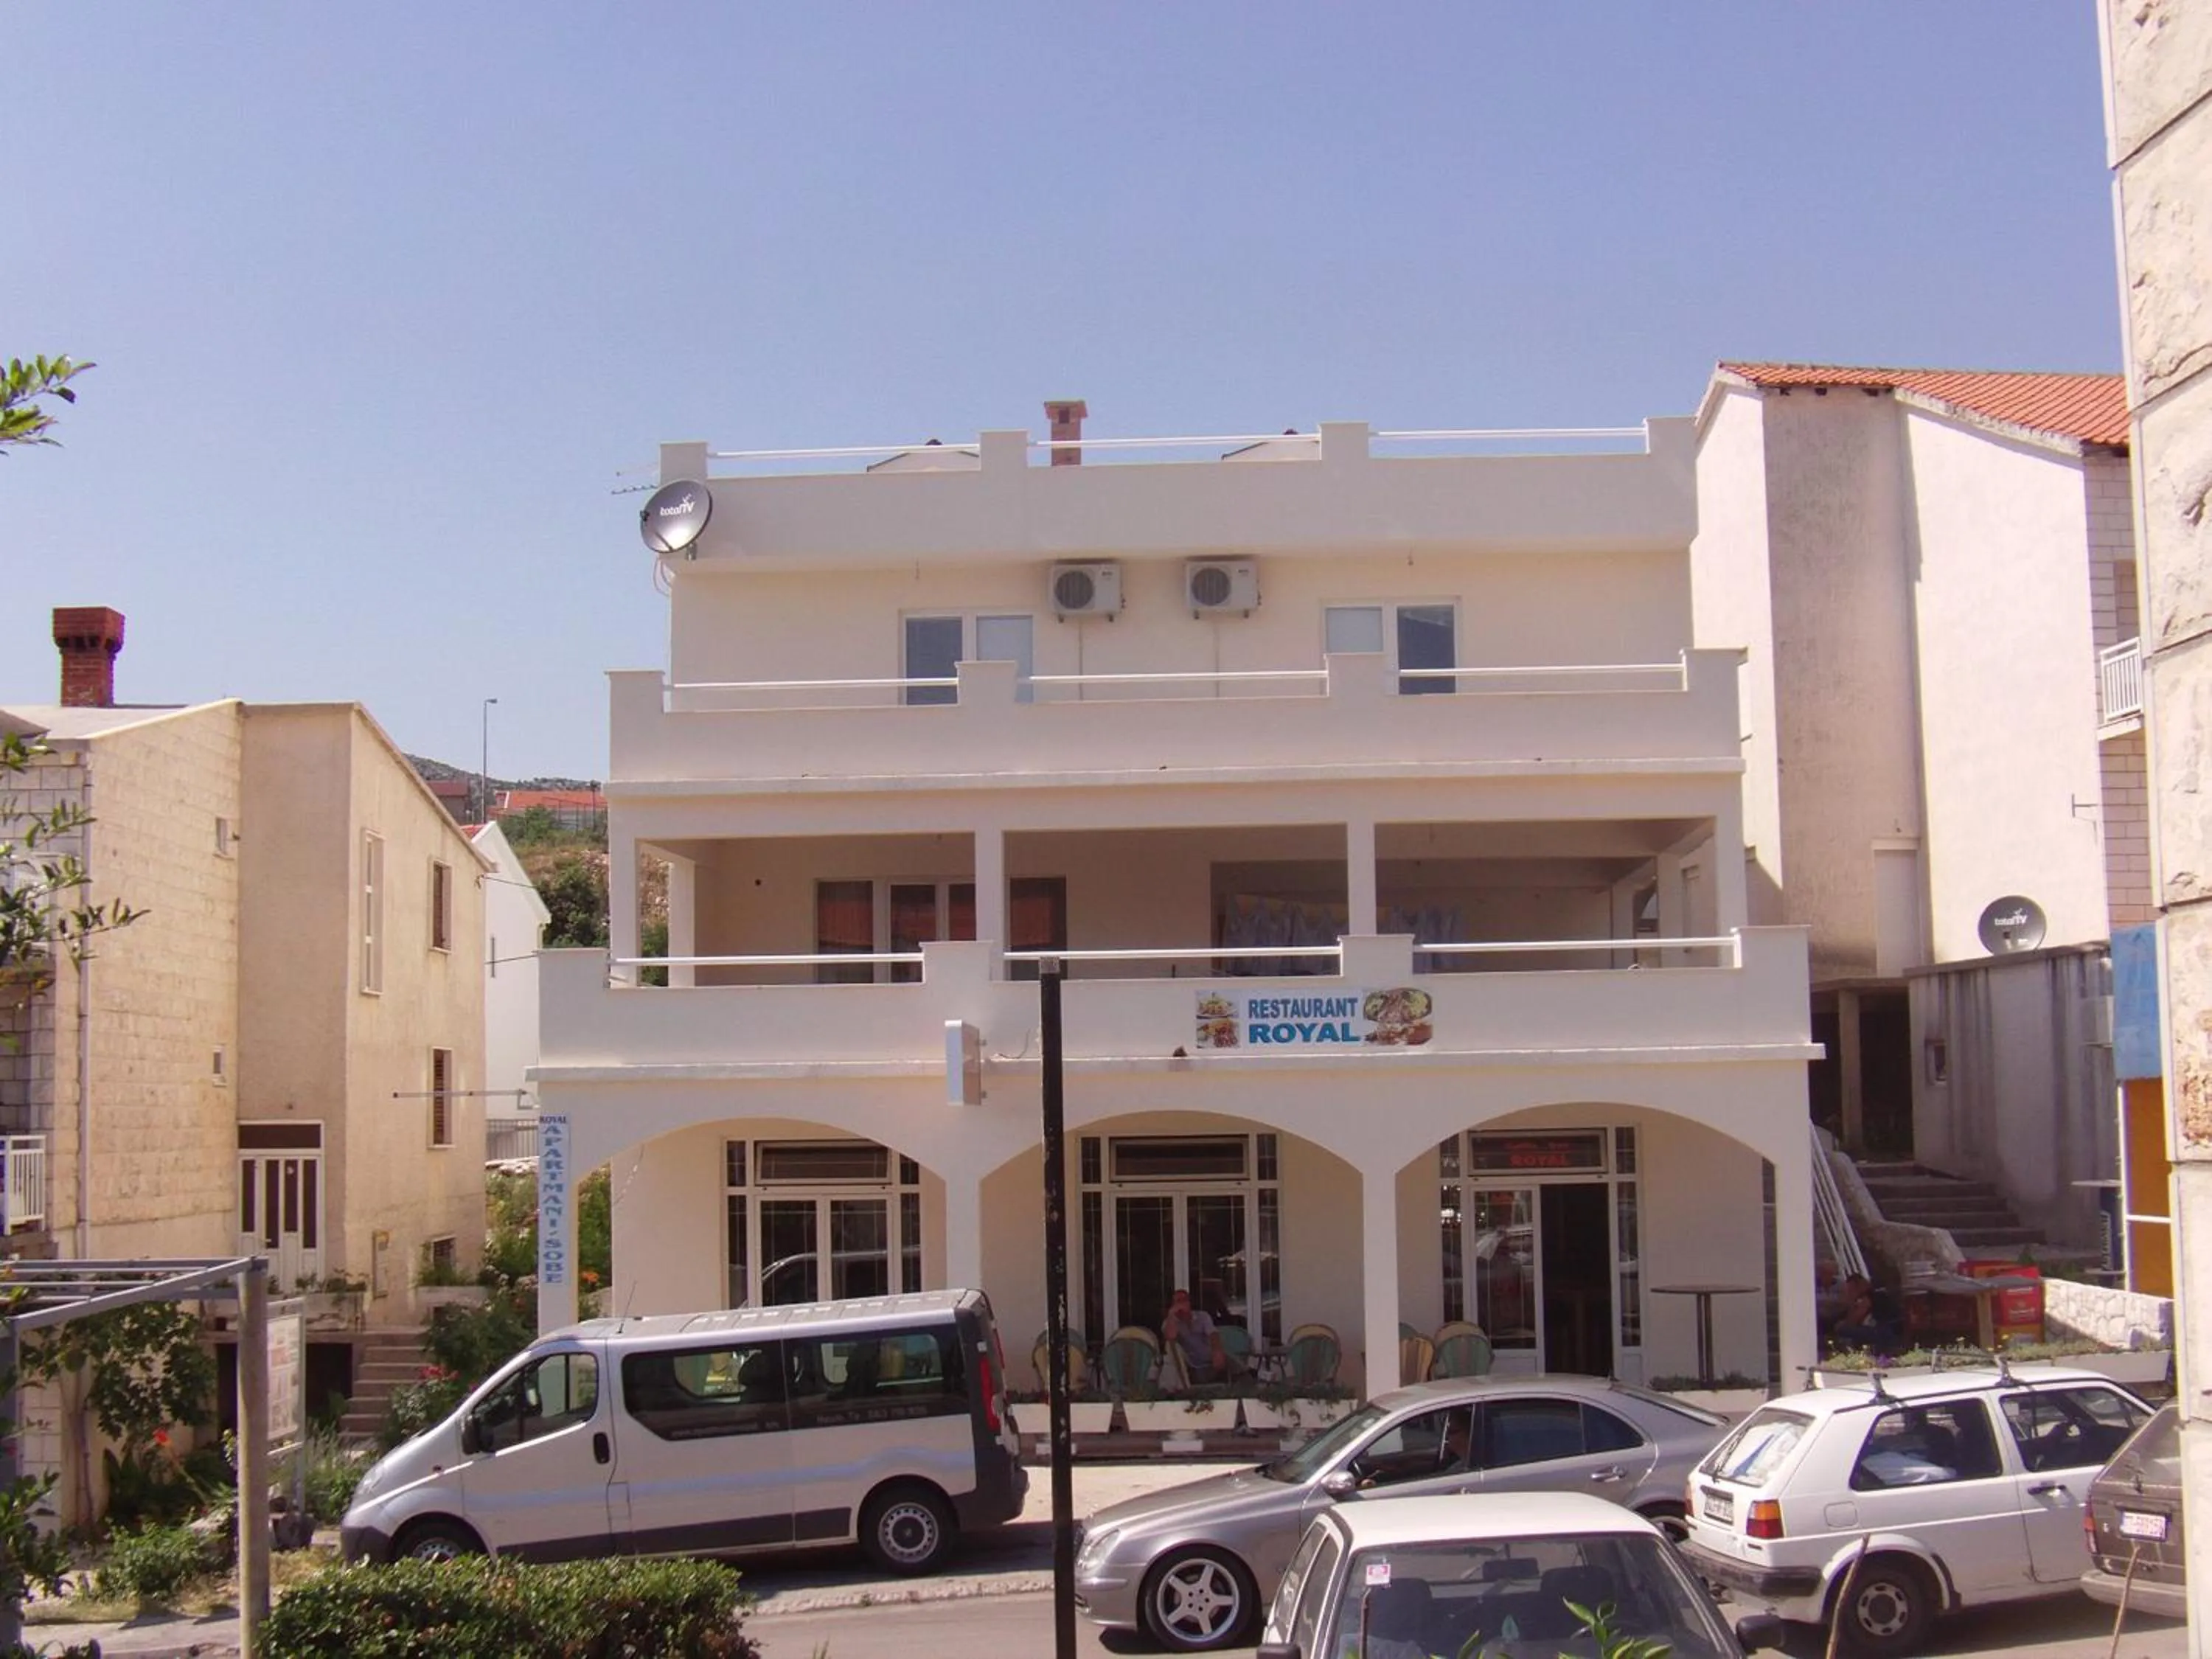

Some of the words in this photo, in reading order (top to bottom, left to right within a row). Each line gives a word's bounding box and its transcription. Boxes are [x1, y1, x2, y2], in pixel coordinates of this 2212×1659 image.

[1248, 998, 1357, 1018] RESTAURANT
[1248, 1022, 1361, 1043] ROYAL
[539, 1116, 566, 1124] ROYAL
[1510, 1154, 1566, 1166] ROYAL
